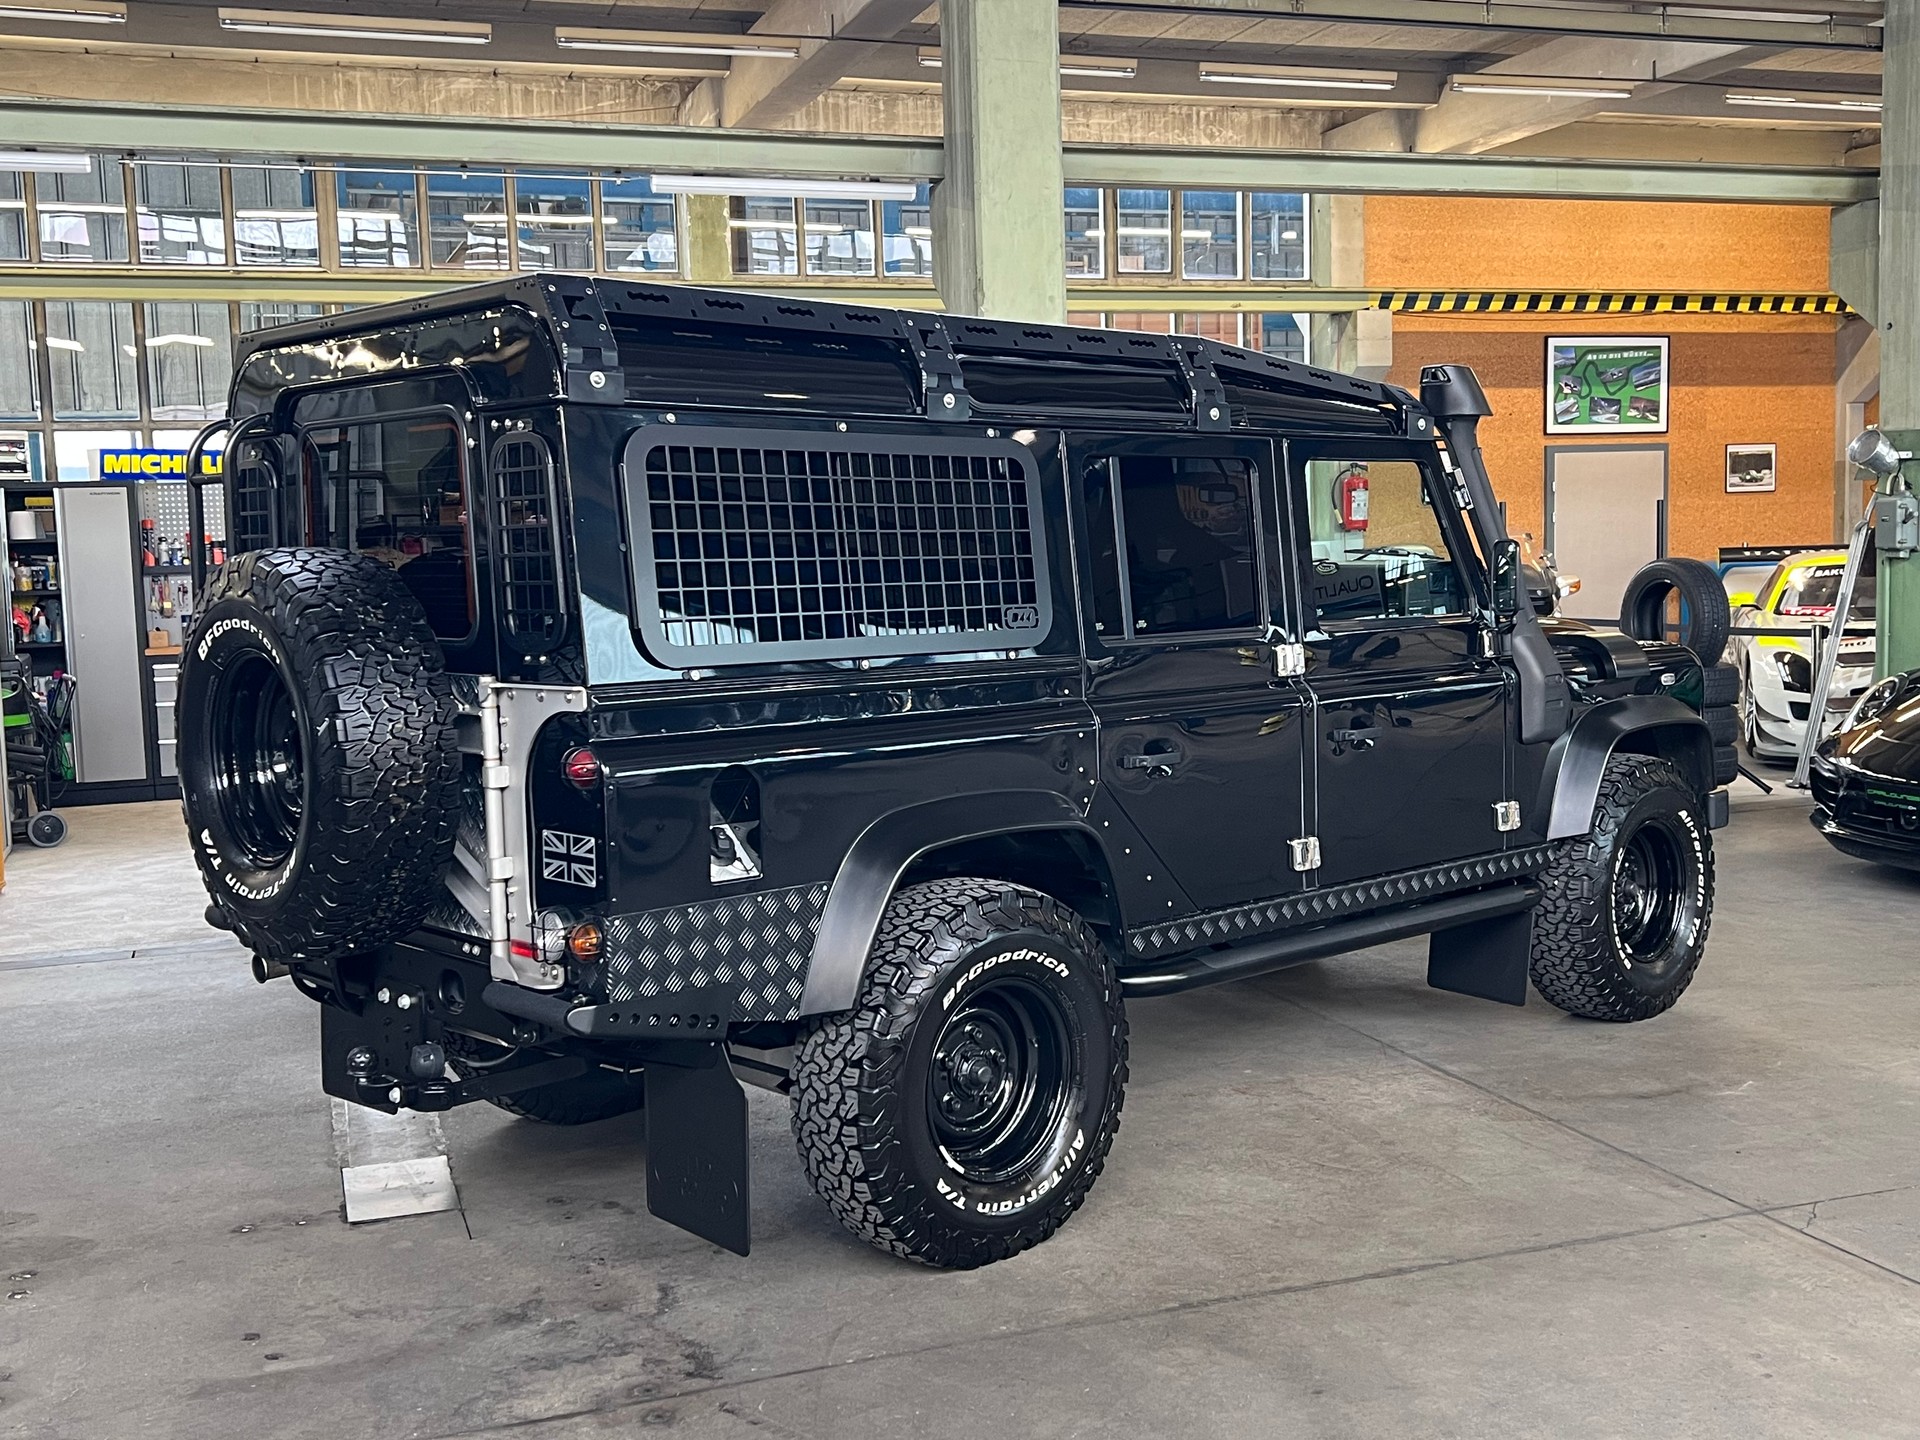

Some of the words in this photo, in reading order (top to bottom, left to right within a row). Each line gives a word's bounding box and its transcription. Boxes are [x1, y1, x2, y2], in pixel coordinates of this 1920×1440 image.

[197, 618, 280, 665] BFGoodrich
[201, 828, 222, 871] T/A
[225, 847, 297, 900] All-Terrain
[1678, 809, 1705, 908] All-Terrain
[1686, 917, 1701, 948] T/A
[942, 948, 1070, 1011] BFGoodrich
[936, 1177, 967, 1210] T/A
[976, 1128, 1085, 1216] All-Terrain
